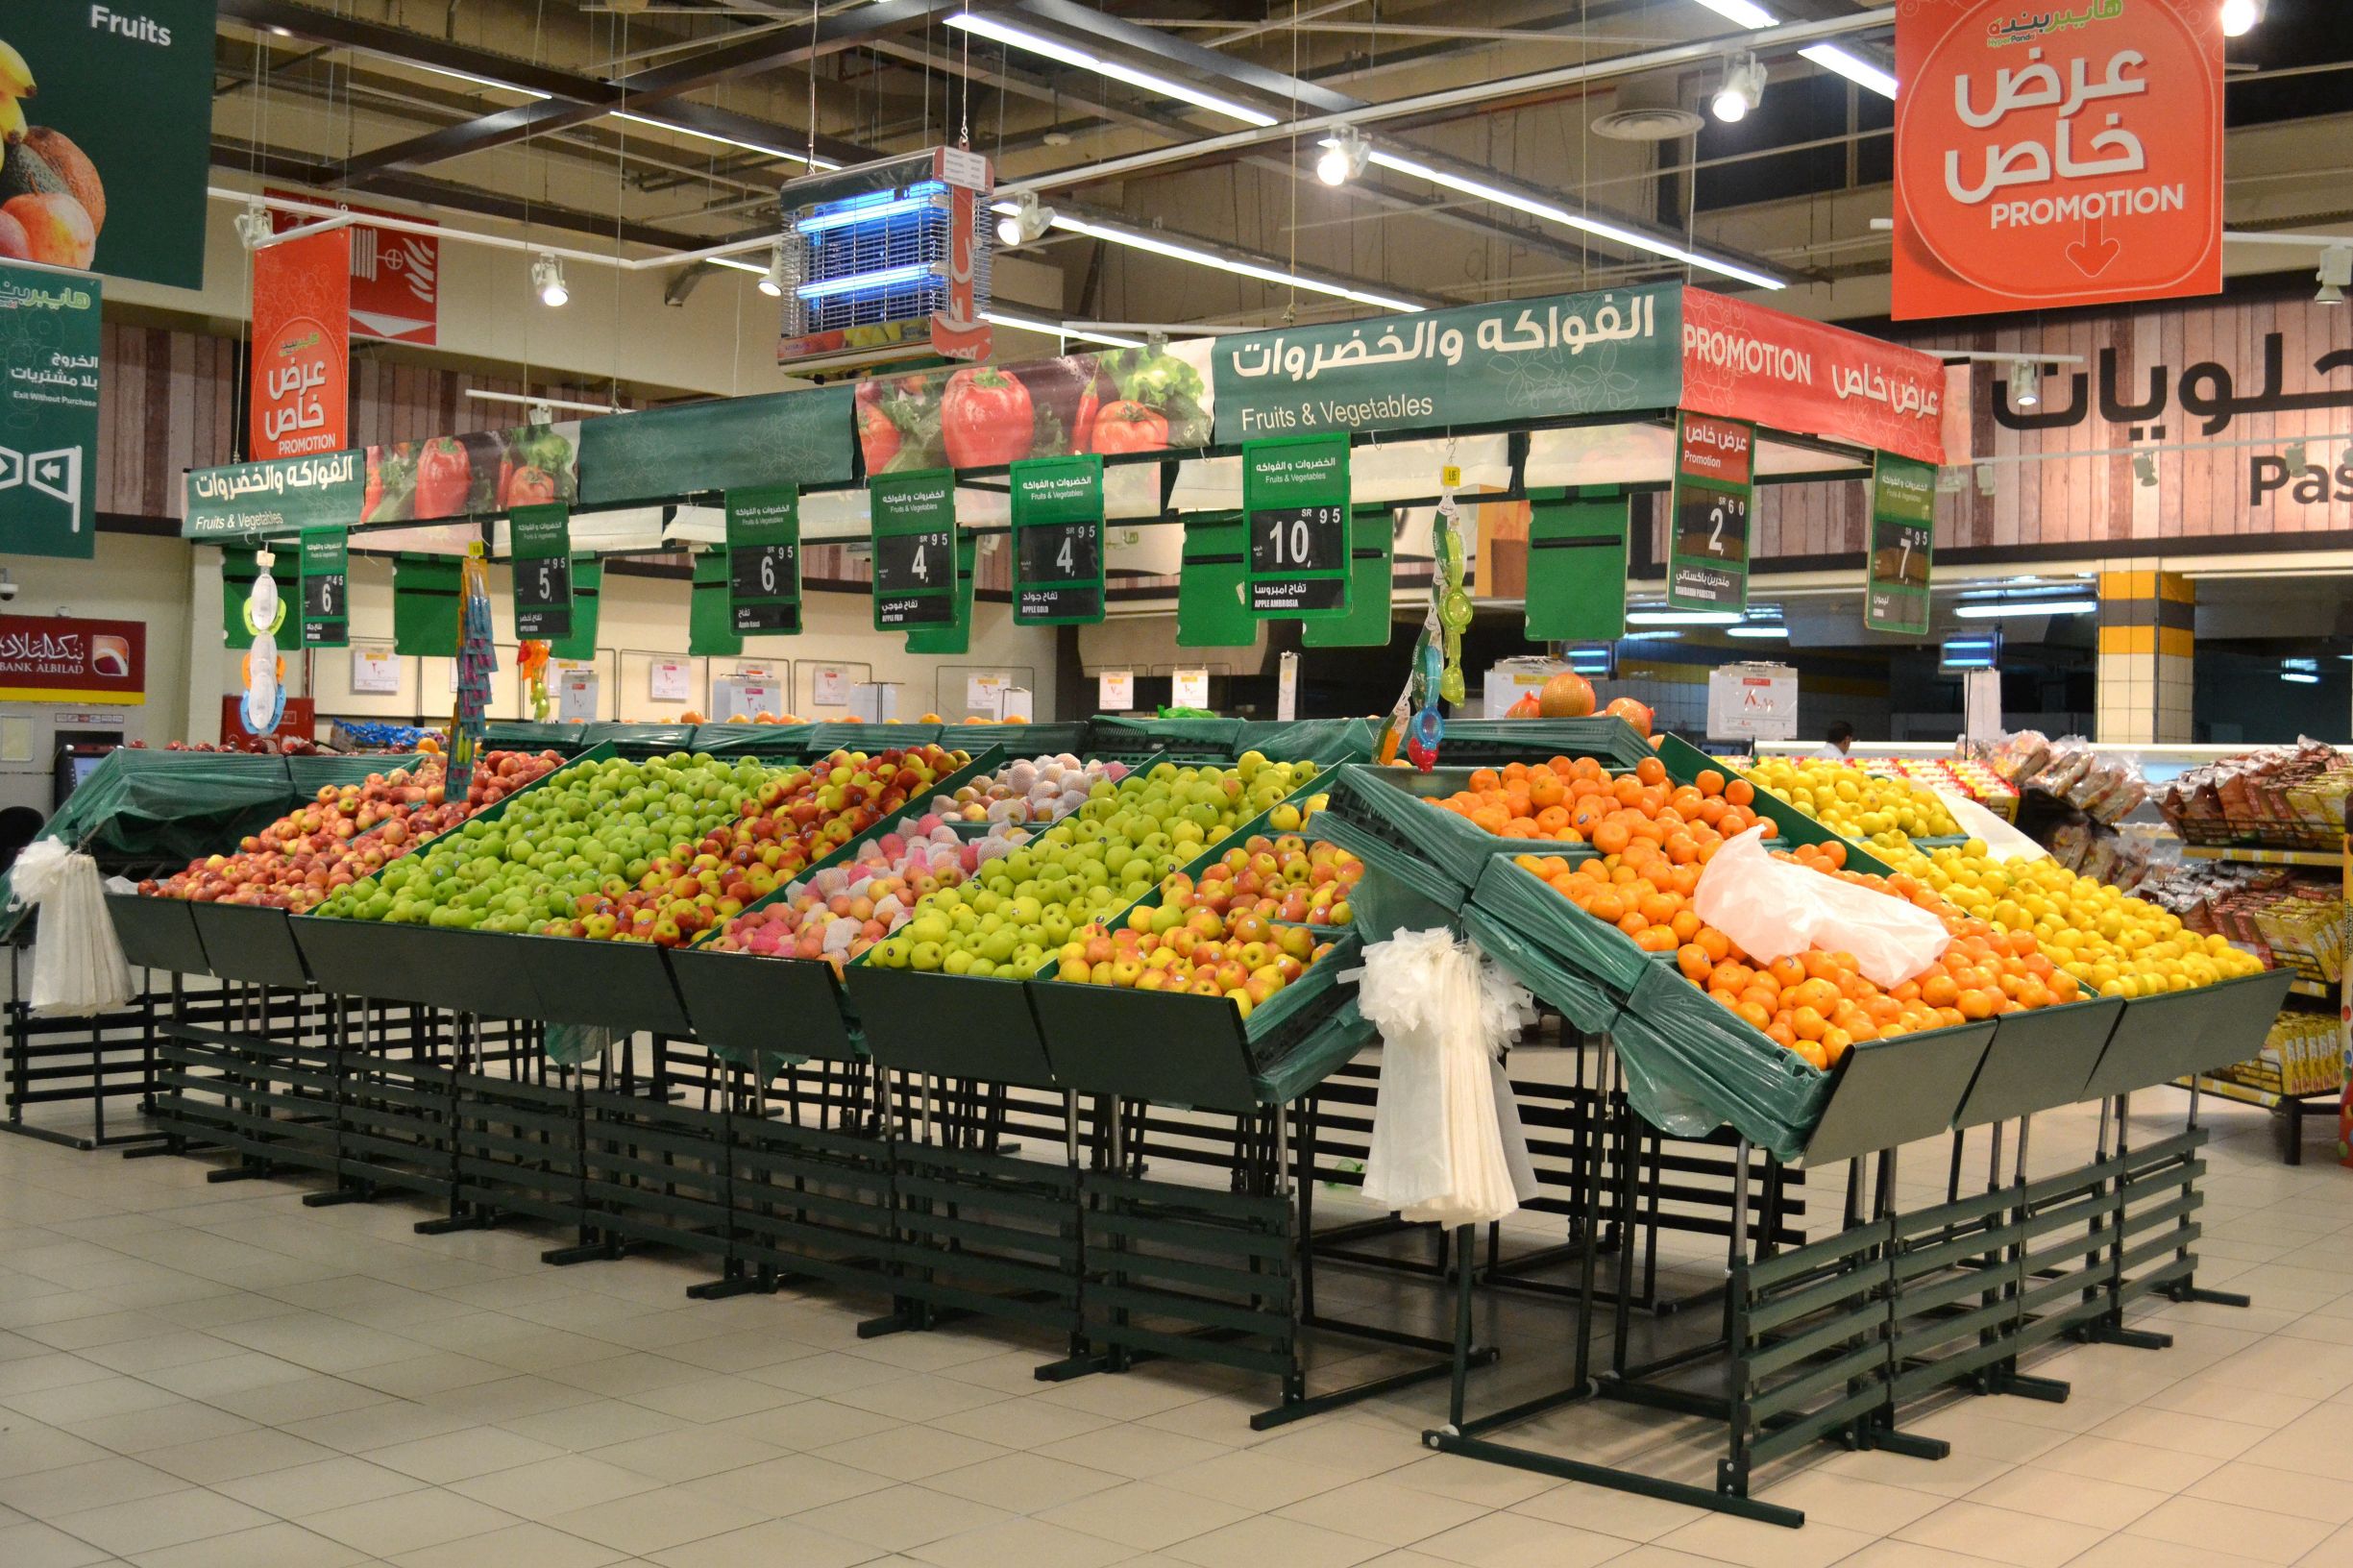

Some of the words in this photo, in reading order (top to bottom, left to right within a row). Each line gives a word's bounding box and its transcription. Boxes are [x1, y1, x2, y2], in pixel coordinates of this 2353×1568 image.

[91, 5, 171, 46] Fruits
[1954, 46, 2147, 128] عرض
[1945, 113, 2145, 204] خاص
[1990, 184, 2183, 230] PROMOTION
[1477, 293, 1655, 355] الفواكه
[51, 352, 98, 368] الخروج
[1233, 320, 1463, 381] والخضروات
[1683, 324, 1811, 384] PROMOTION
[11, 367, 78, 386] مشتريات
[81, 376, 98, 390] بلا
[269, 357, 326, 400] عرض
[1831, 362, 1888, 402] خاص
[12, 390, 29, 400] Exit
[30, 393, 61, 403] Without
[61, 396, 97, 406] Purchase
[1891, 377, 1939, 419] عرض
[265, 394, 325, 442] خاص
[1241, 404, 1296, 431] Fruits
[1301, 402, 1316, 426] &
[1319, 394, 1434, 427] Vegetables
[279, 433, 336, 454] PROMOTION
[1685, 425, 1716, 444] خاص
[1718, 431, 1747, 453] عرض
[1256, 462, 1286, 473] الفواكه
[1295, 457, 1336, 470] الخضروات
[1684, 451, 1722, 468] Promotion
[287, 454, 354, 490] الفواكه
[1057, 476, 1091, 487] الخضروات
[1265, 475, 1283, 483] Fruits
[1291, 472, 1326, 483] Vegetables
[196, 464, 283, 502] والخضروات
[1022, 479, 1048, 490] الفواكه
[882, 494, 907, 503] الفواكه
[914, 491, 944, 501] الخضروات
[1031, 492, 1046, 501] Fruits
[1053, 490, 1084, 500] Vegetables
[910, 503, 938, 513] Vegetables
[195, 515, 225, 530] Fruits
[227, 514, 235, 527] &
[237, 511, 284, 529] Vegetables
[1022, 592, 1042, 601] جولد
[1042, 591, 1058, 601] تفاح
[1288, 582, 1307, 594] تفاح
[903, 600, 918, 610] تفاح
[0, 662, 33, 672] BANK
[37, 664, 84, 674] ALBILAD
